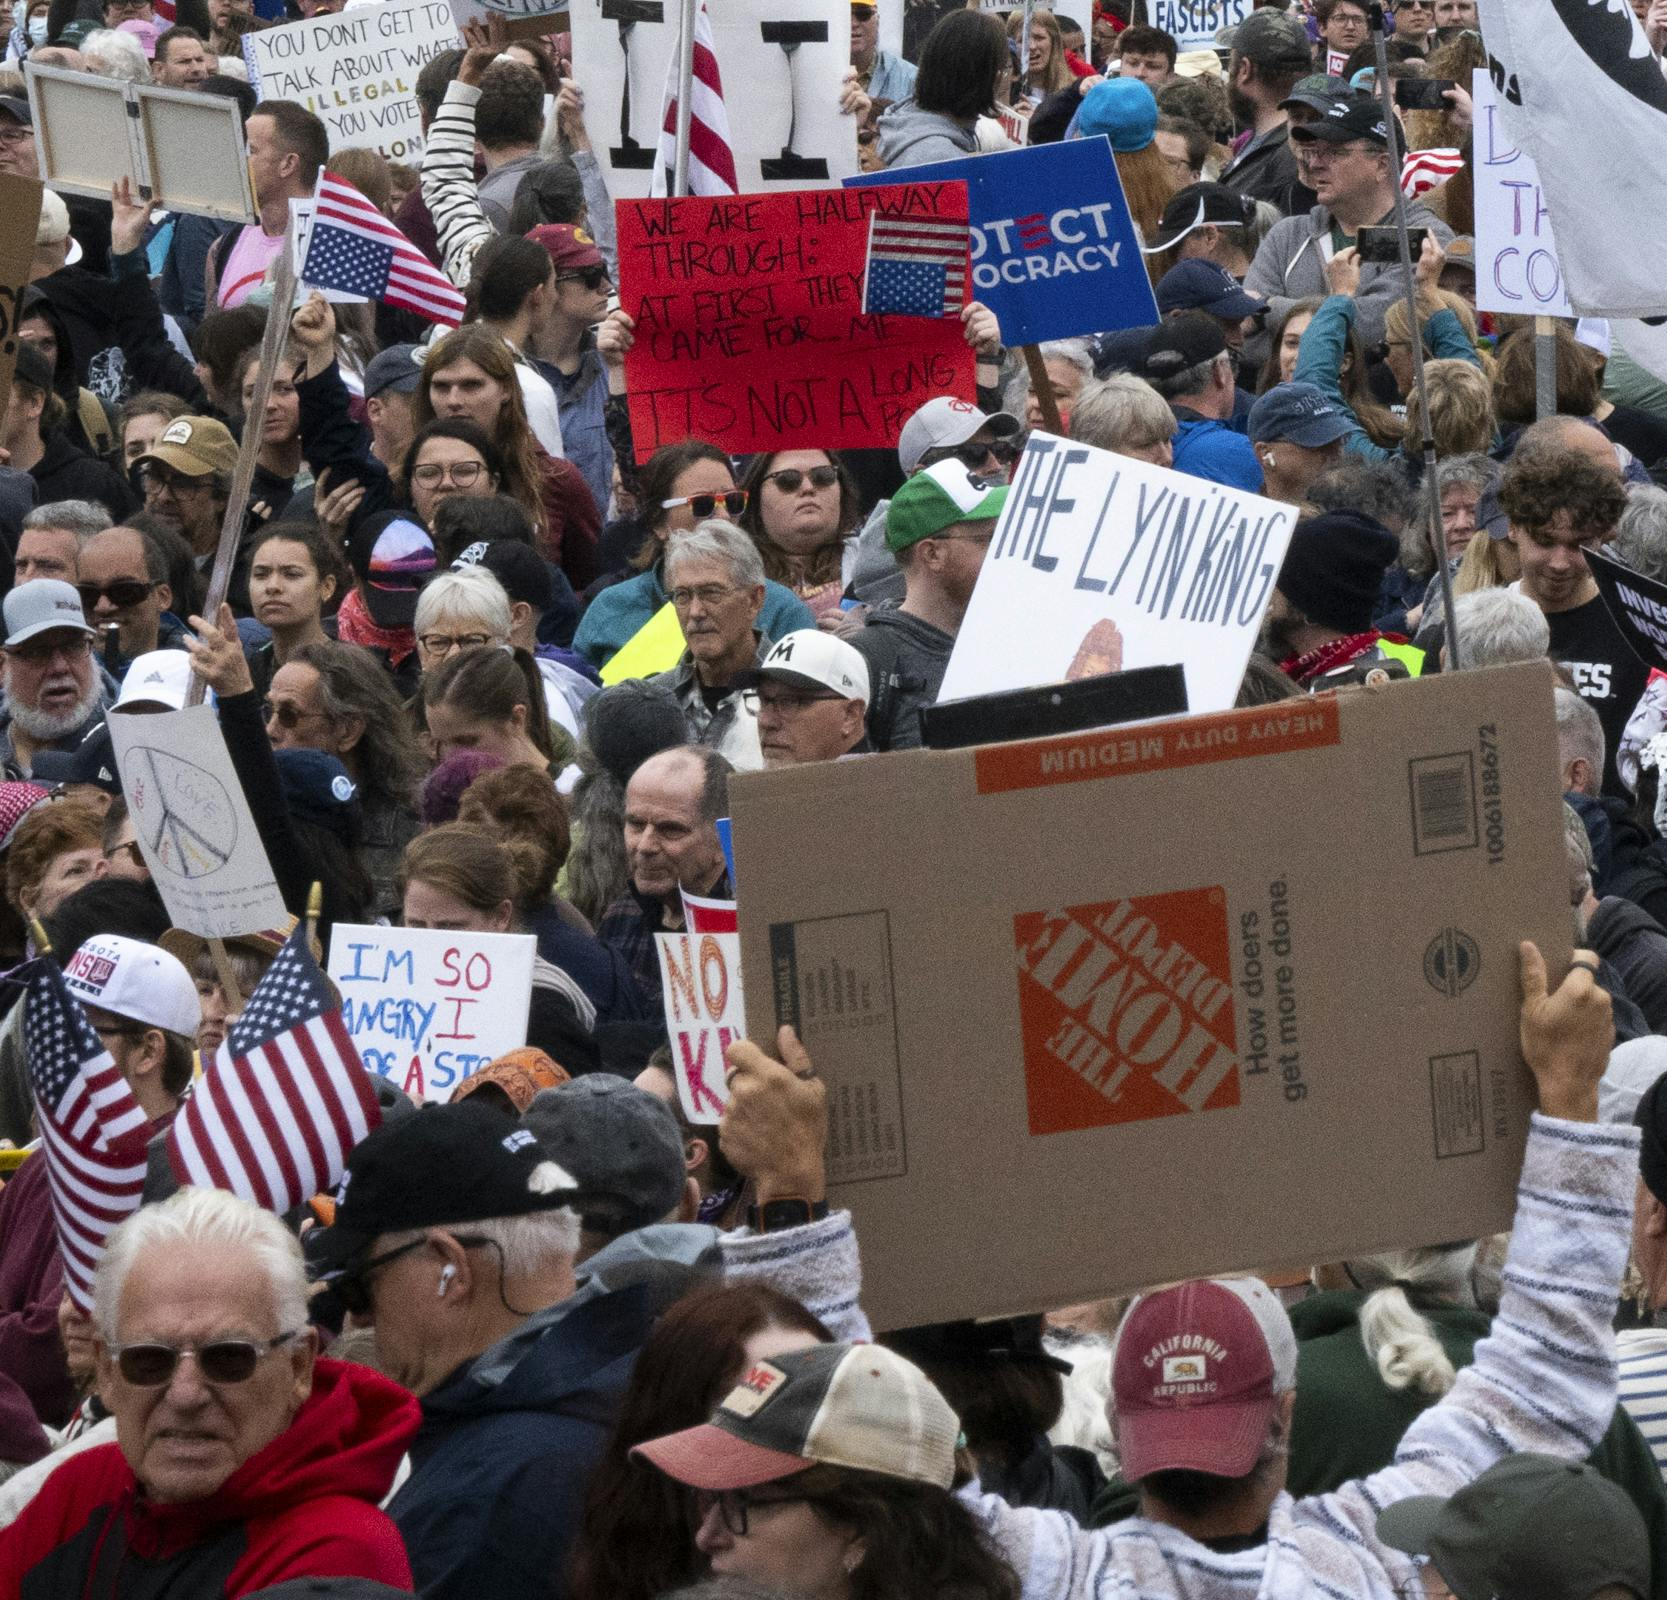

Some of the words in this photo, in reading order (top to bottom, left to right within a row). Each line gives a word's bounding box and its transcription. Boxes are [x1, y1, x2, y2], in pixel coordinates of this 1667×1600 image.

[636, 202, 686, 238] WE
[706, 202, 761, 233] ARE
[800, 184, 944, 223] HALFWAY
[636, 235, 819, 279] THROUGH:
[1176, 725, 1238, 752] DUTY
[1246, 714, 1324, 742] HEAVY
[1040, 737, 1164, 774] MEDIUM
[1270, 875, 1289, 960] done.
[339, 943, 414, 985] I'M
[434, 942, 492, 992] SO
[1096, 899, 1233, 1023] DEPOT
[1240, 909, 1265, 997] doers
[1015, 904, 1238, 1112] HOME
[1276, 965, 1295, 1042] more
[1044, 1016, 1134, 1103] THE
[1244, 1005, 1268, 1077] How
[1283, 1048, 1308, 1102] get
[1142, 1334, 1229, 1370] CALIFORNIA
[1153, 1379, 1218, 1398] REPUBLIC
